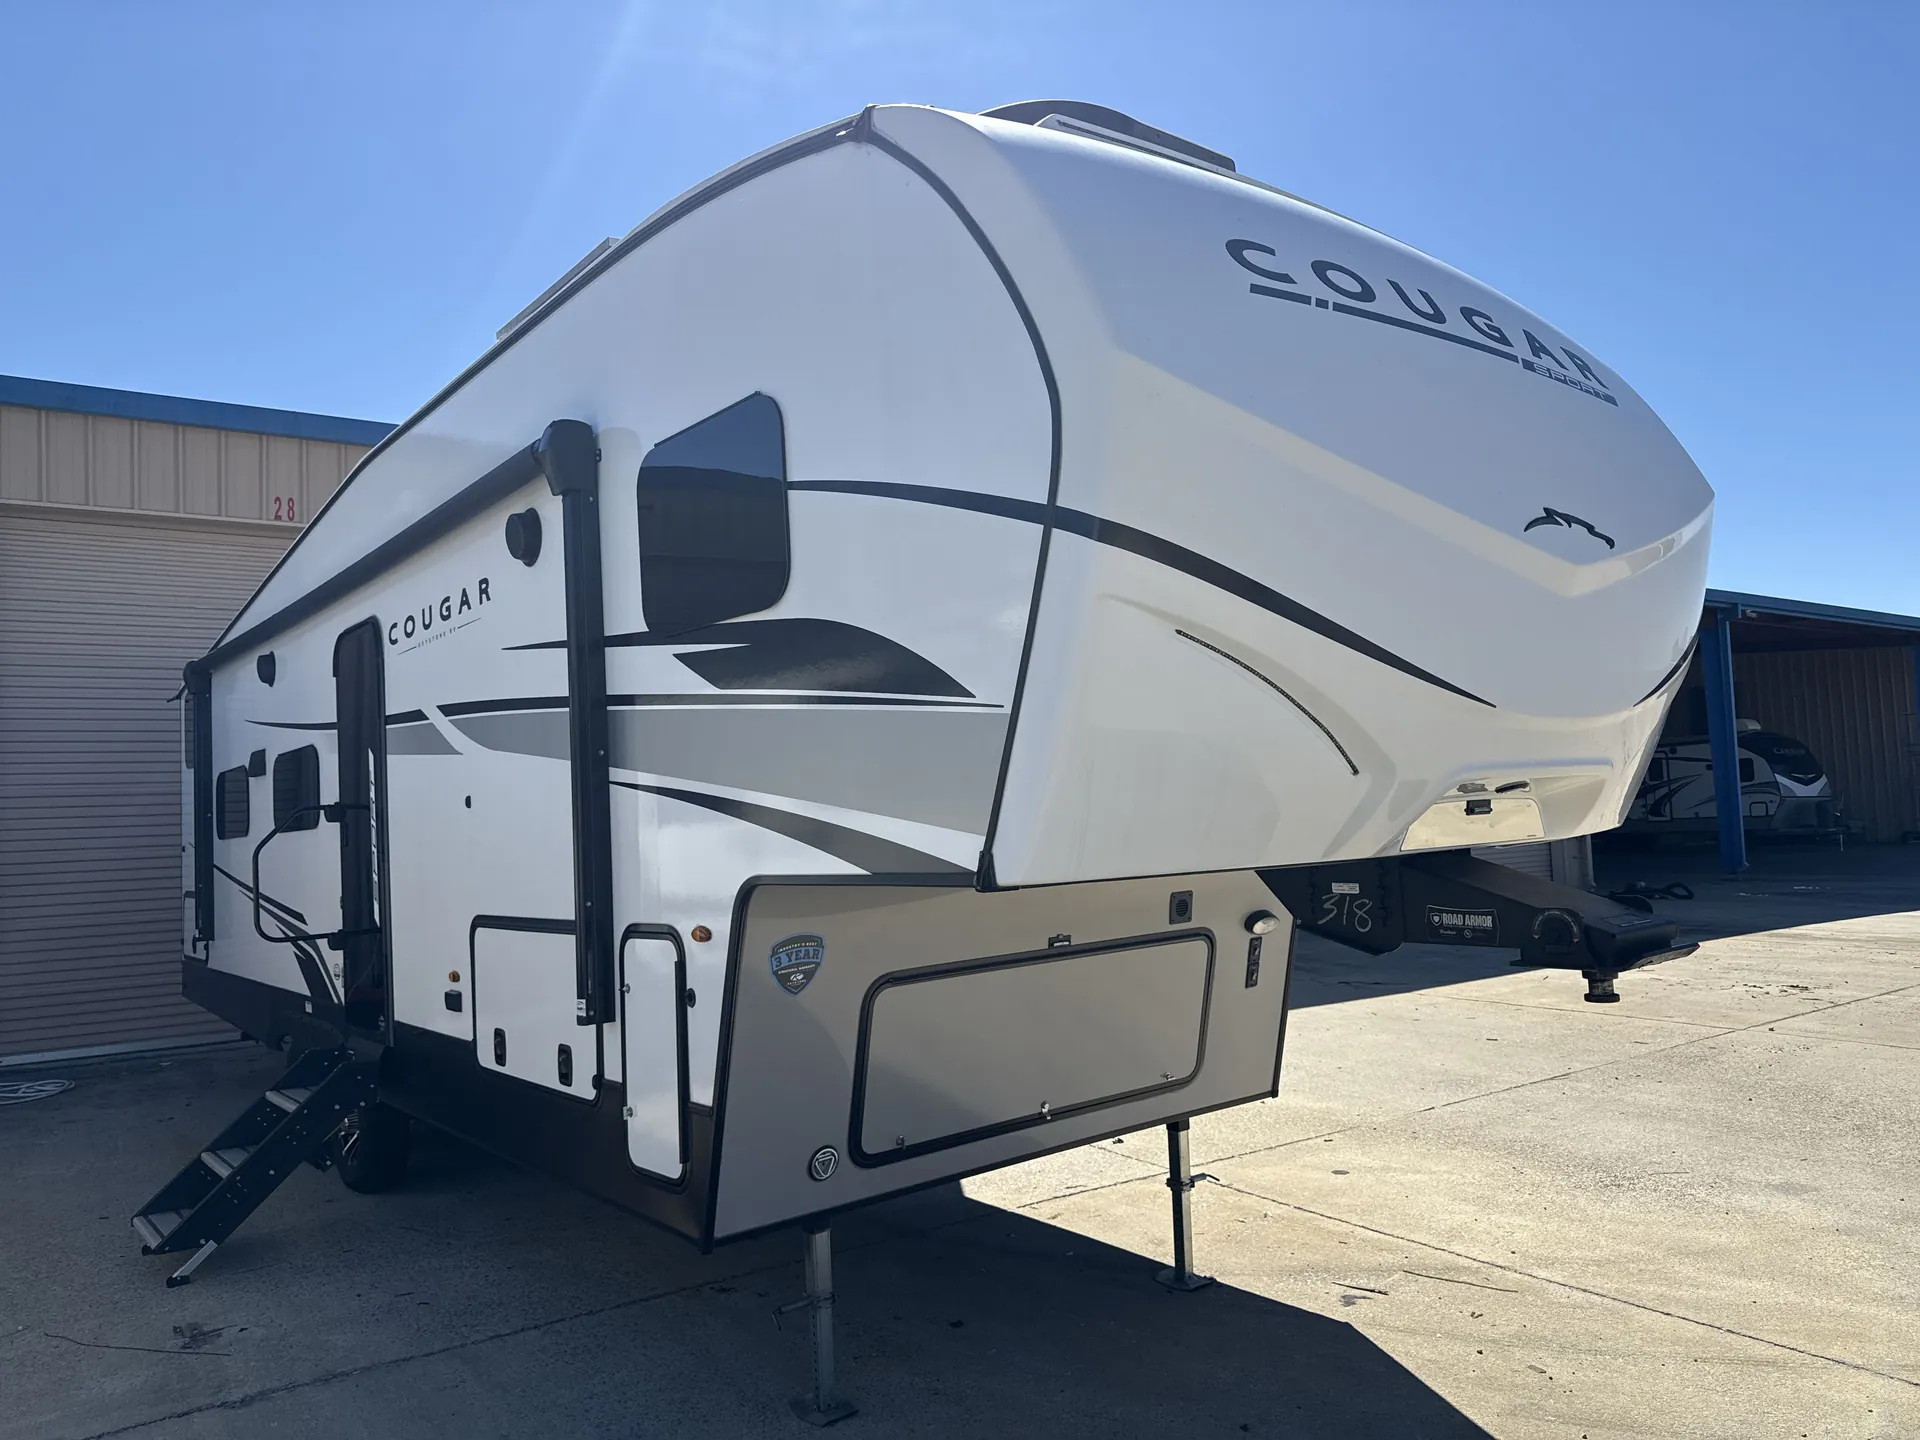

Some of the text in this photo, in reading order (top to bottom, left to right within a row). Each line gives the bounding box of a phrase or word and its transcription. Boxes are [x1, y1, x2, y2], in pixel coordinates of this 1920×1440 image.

[1225, 239, 1609, 390] COUGAR
[1533, 363, 1607, 399] SPORT
[273, 496, 295, 521] 28
[388, 577, 491, 645] COUGAR
[1317, 893, 1373, 933] 318
[1442, 912, 1464, 926] ROAD
[1464, 914, 1493, 928] ARMOR
[785, 948, 820, 963] YEAR
